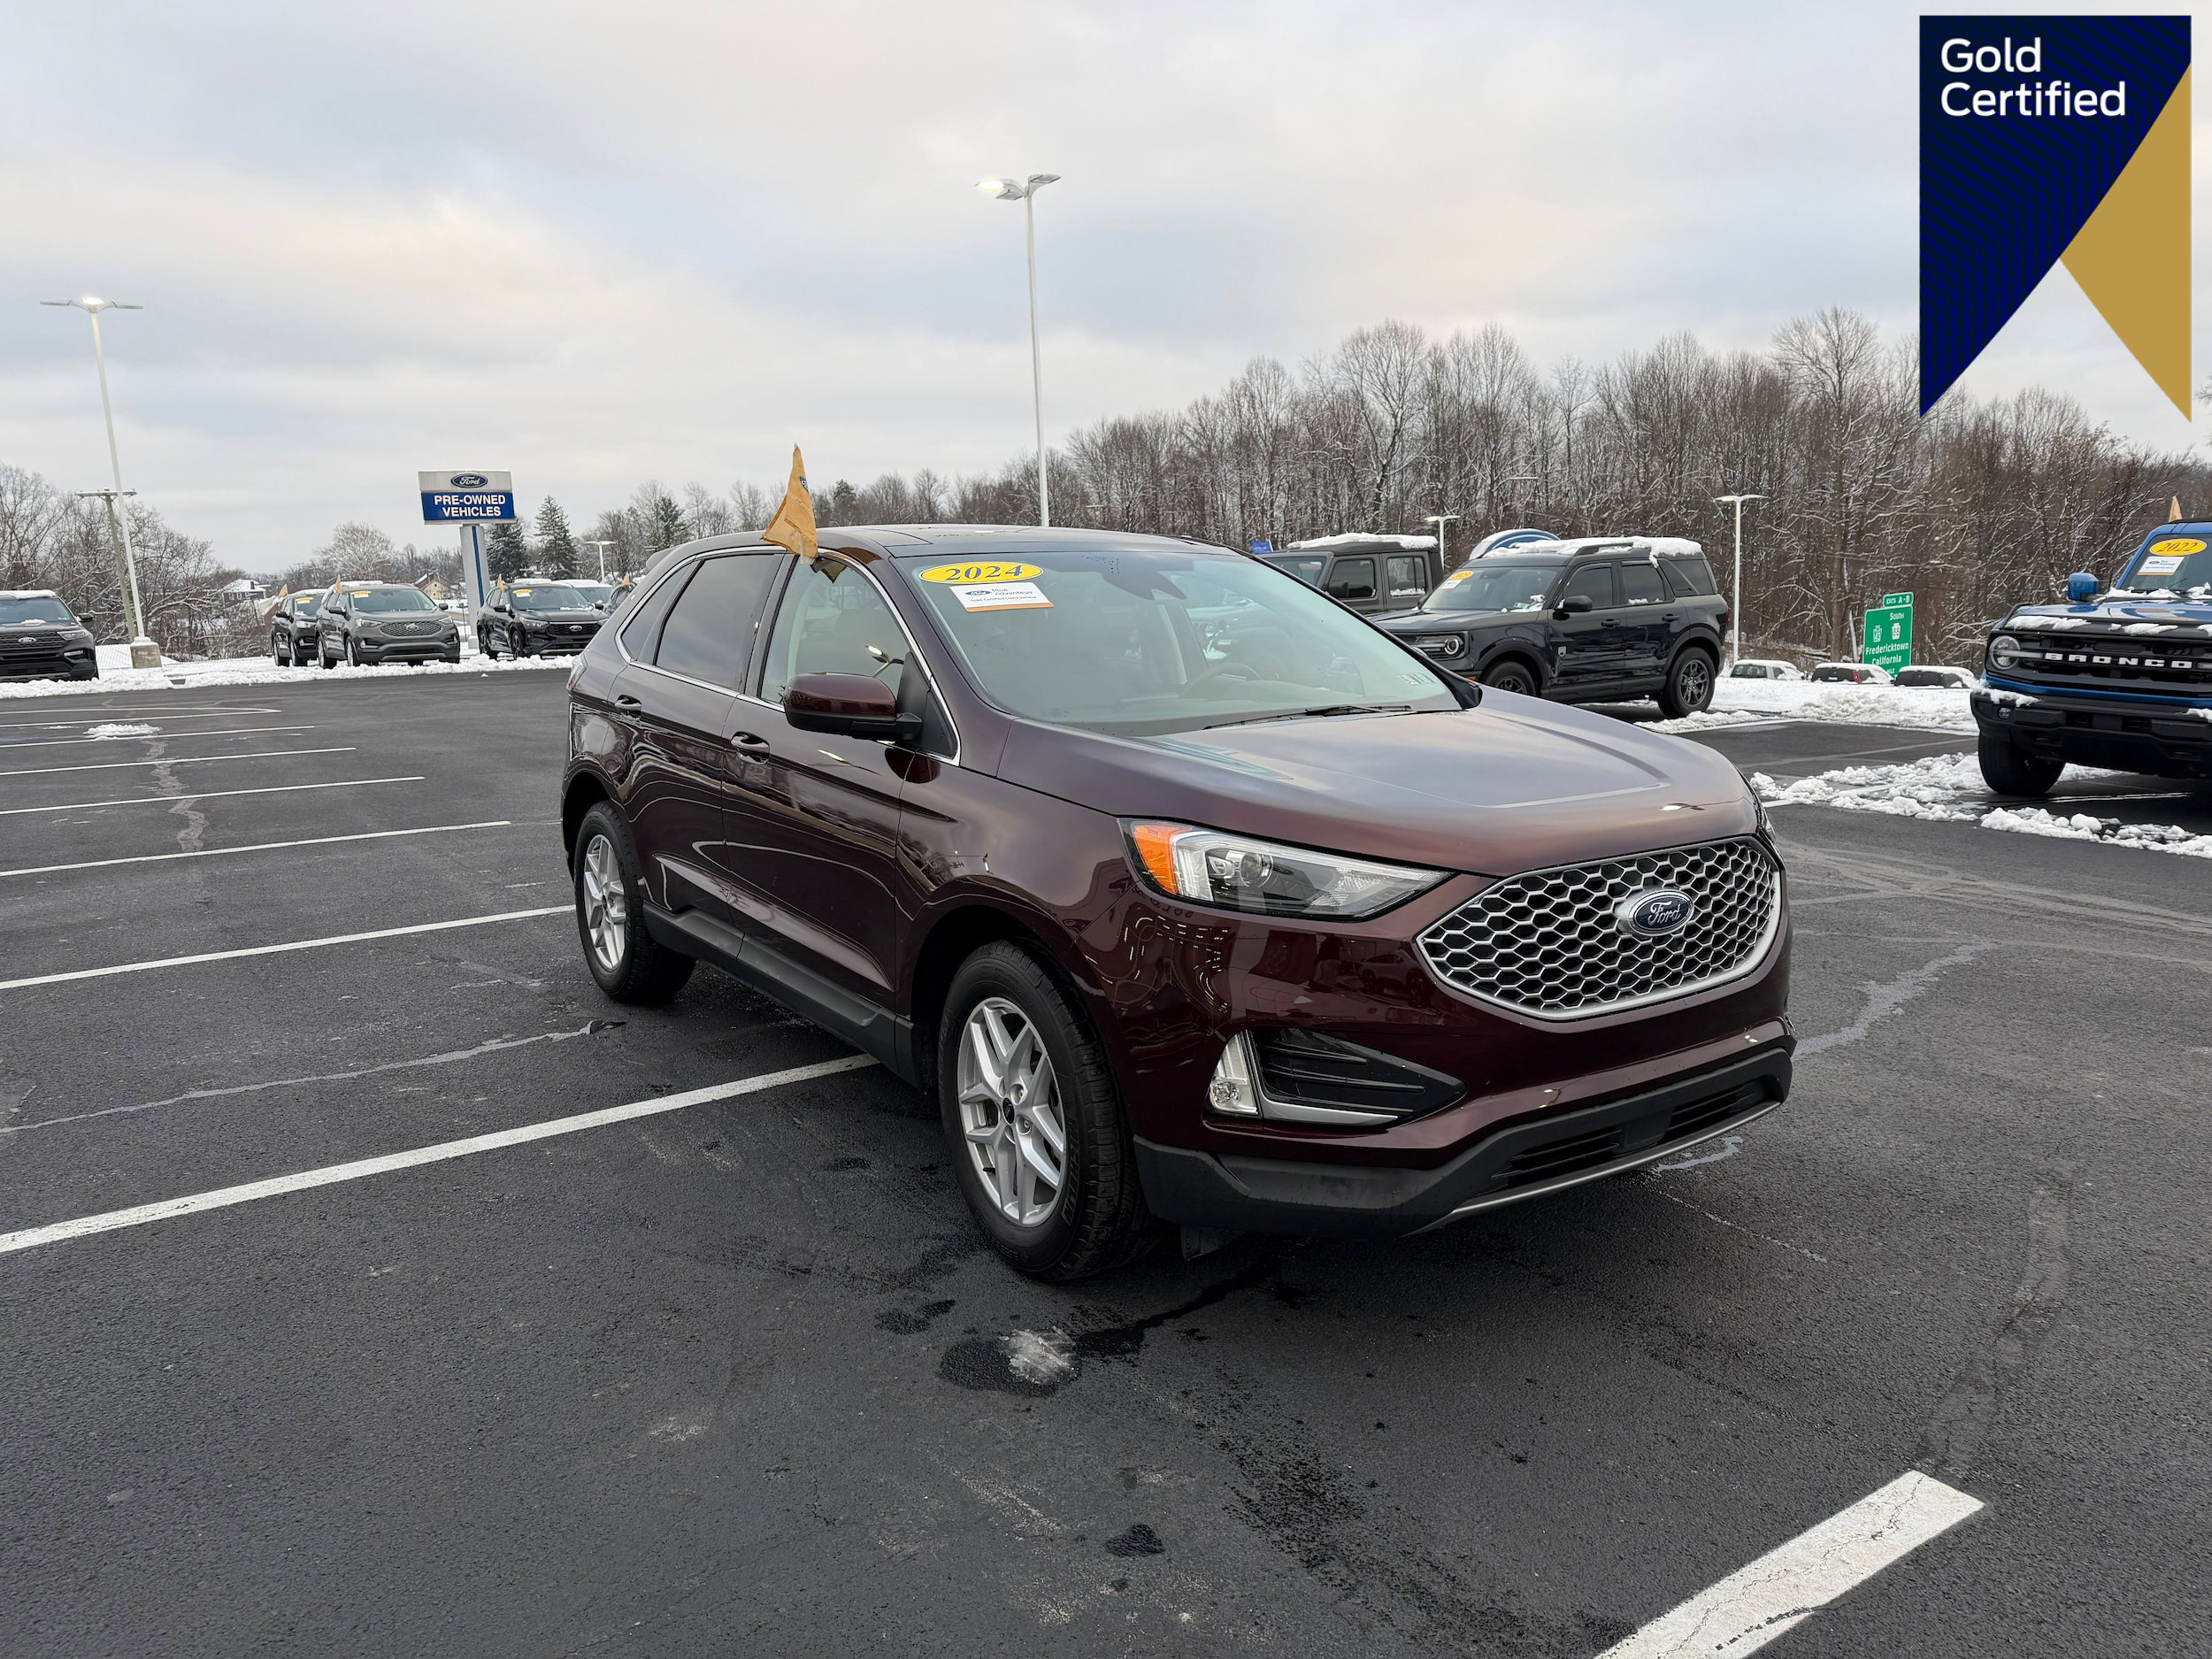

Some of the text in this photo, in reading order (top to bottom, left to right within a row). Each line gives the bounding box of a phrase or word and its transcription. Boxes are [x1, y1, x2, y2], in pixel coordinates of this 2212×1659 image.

[434, 495, 506, 506] PRE-OWNED
[442, 506, 502, 517] VEHICLES
[2157, 541, 2199, 553] 2022
[945, 565, 1023, 581] 2024
[1865, 642, 1909, 655] Fredericktown
[1871, 655, 1902, 665] California
[2045, 652, 2193, 669] BRONCO
[1647, 900, 1682, 926] Ford
